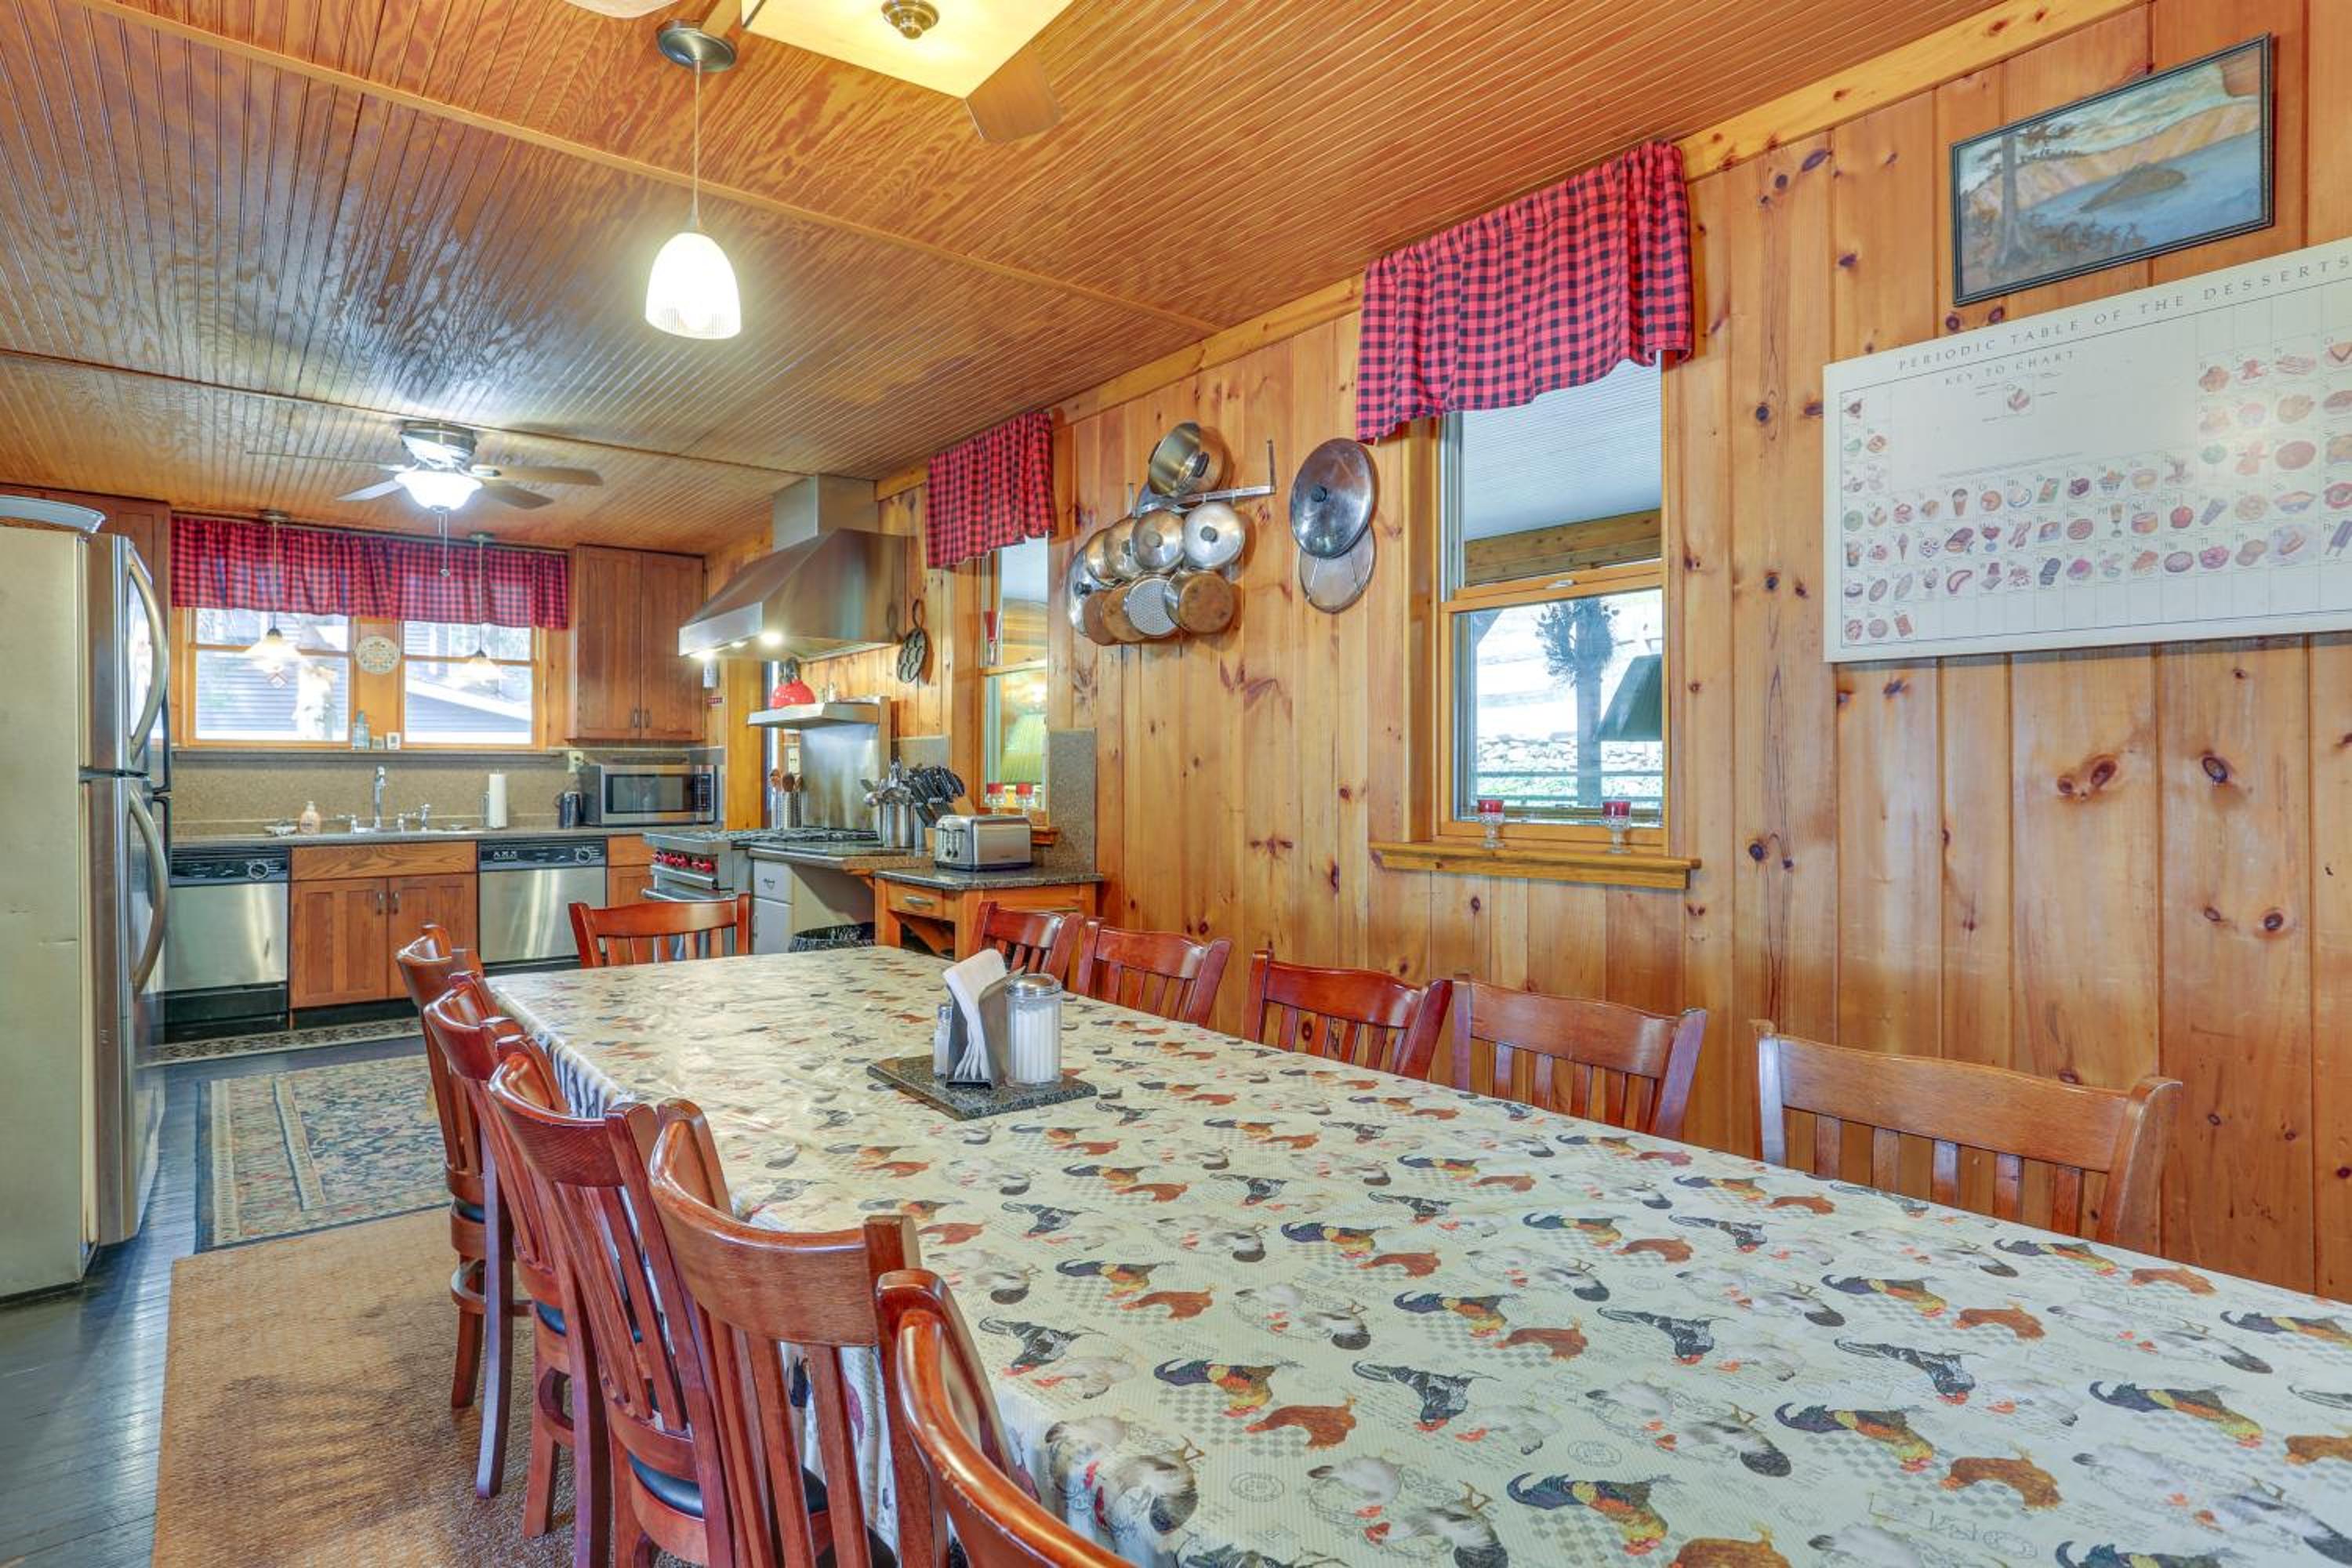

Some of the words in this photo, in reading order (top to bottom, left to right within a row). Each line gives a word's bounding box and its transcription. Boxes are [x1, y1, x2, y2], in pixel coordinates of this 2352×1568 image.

[1899, 339, 1995, 371] PERIODIC
[2010, 321, 2078, 345] TABLE
[2094, 309, 2121, 325] OF
[2140, 295, 2183, 314] THE
[2203, 258, 2350, 301] DESSERTS
[2016, 350, 2074, 371] CHART
